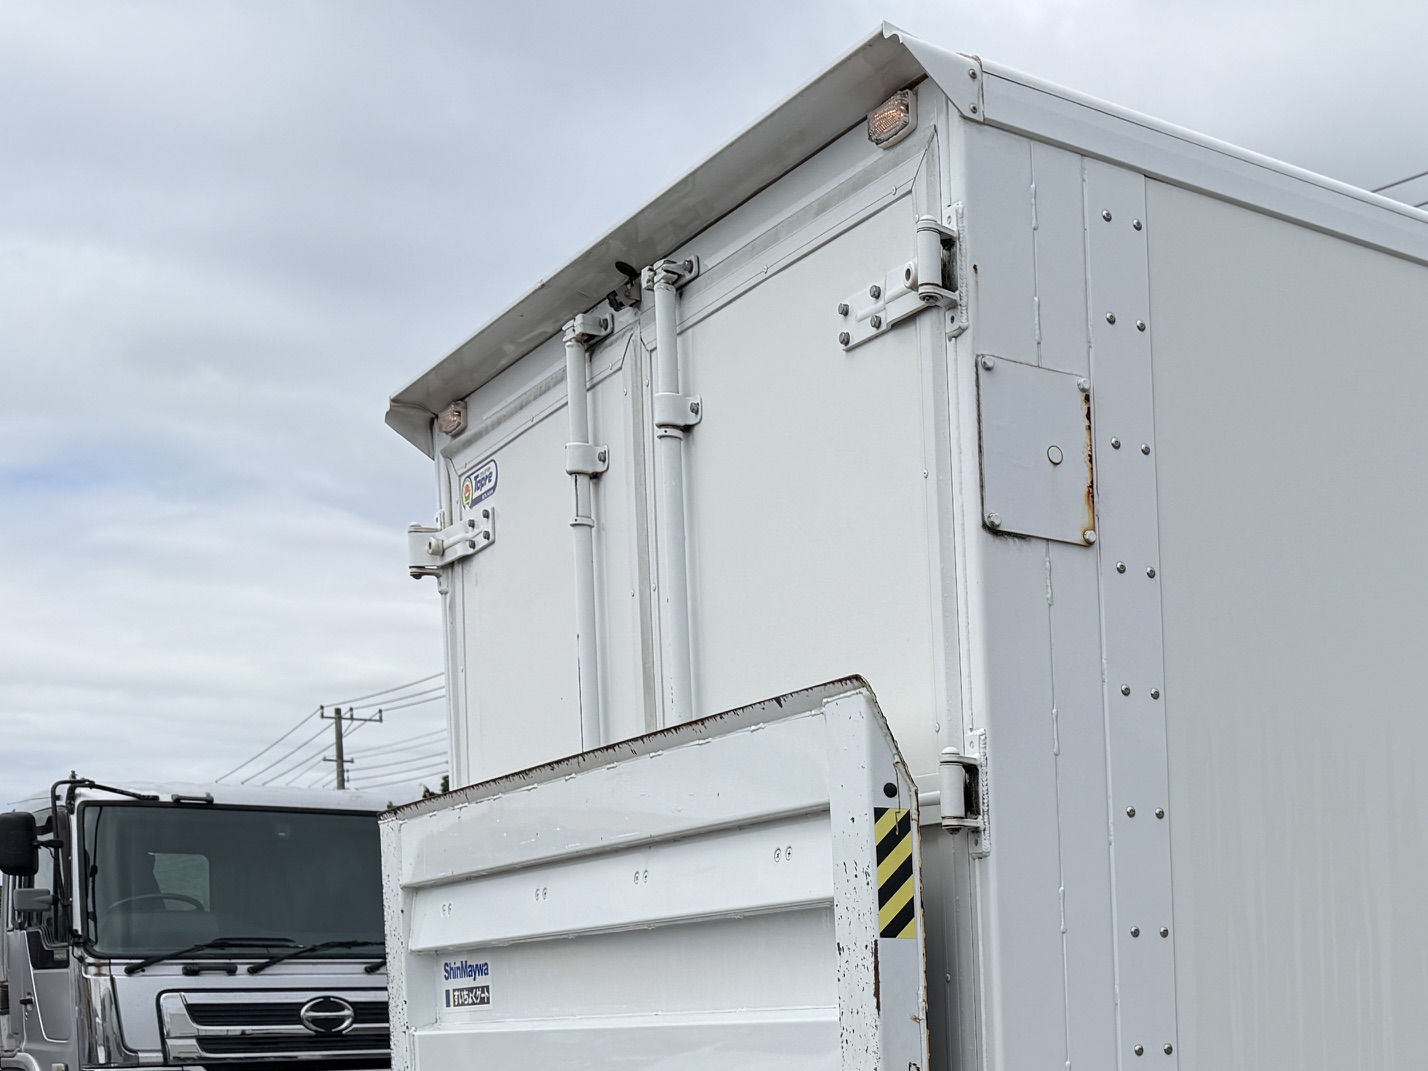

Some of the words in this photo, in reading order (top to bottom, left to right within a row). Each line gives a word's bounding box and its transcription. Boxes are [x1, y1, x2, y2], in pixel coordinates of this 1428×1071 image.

[473, 471, 493, 493] Topre
[443, 960, 489, 981] ShinMaywa
[453, 987, 490, 1006] すいちょくゲート
